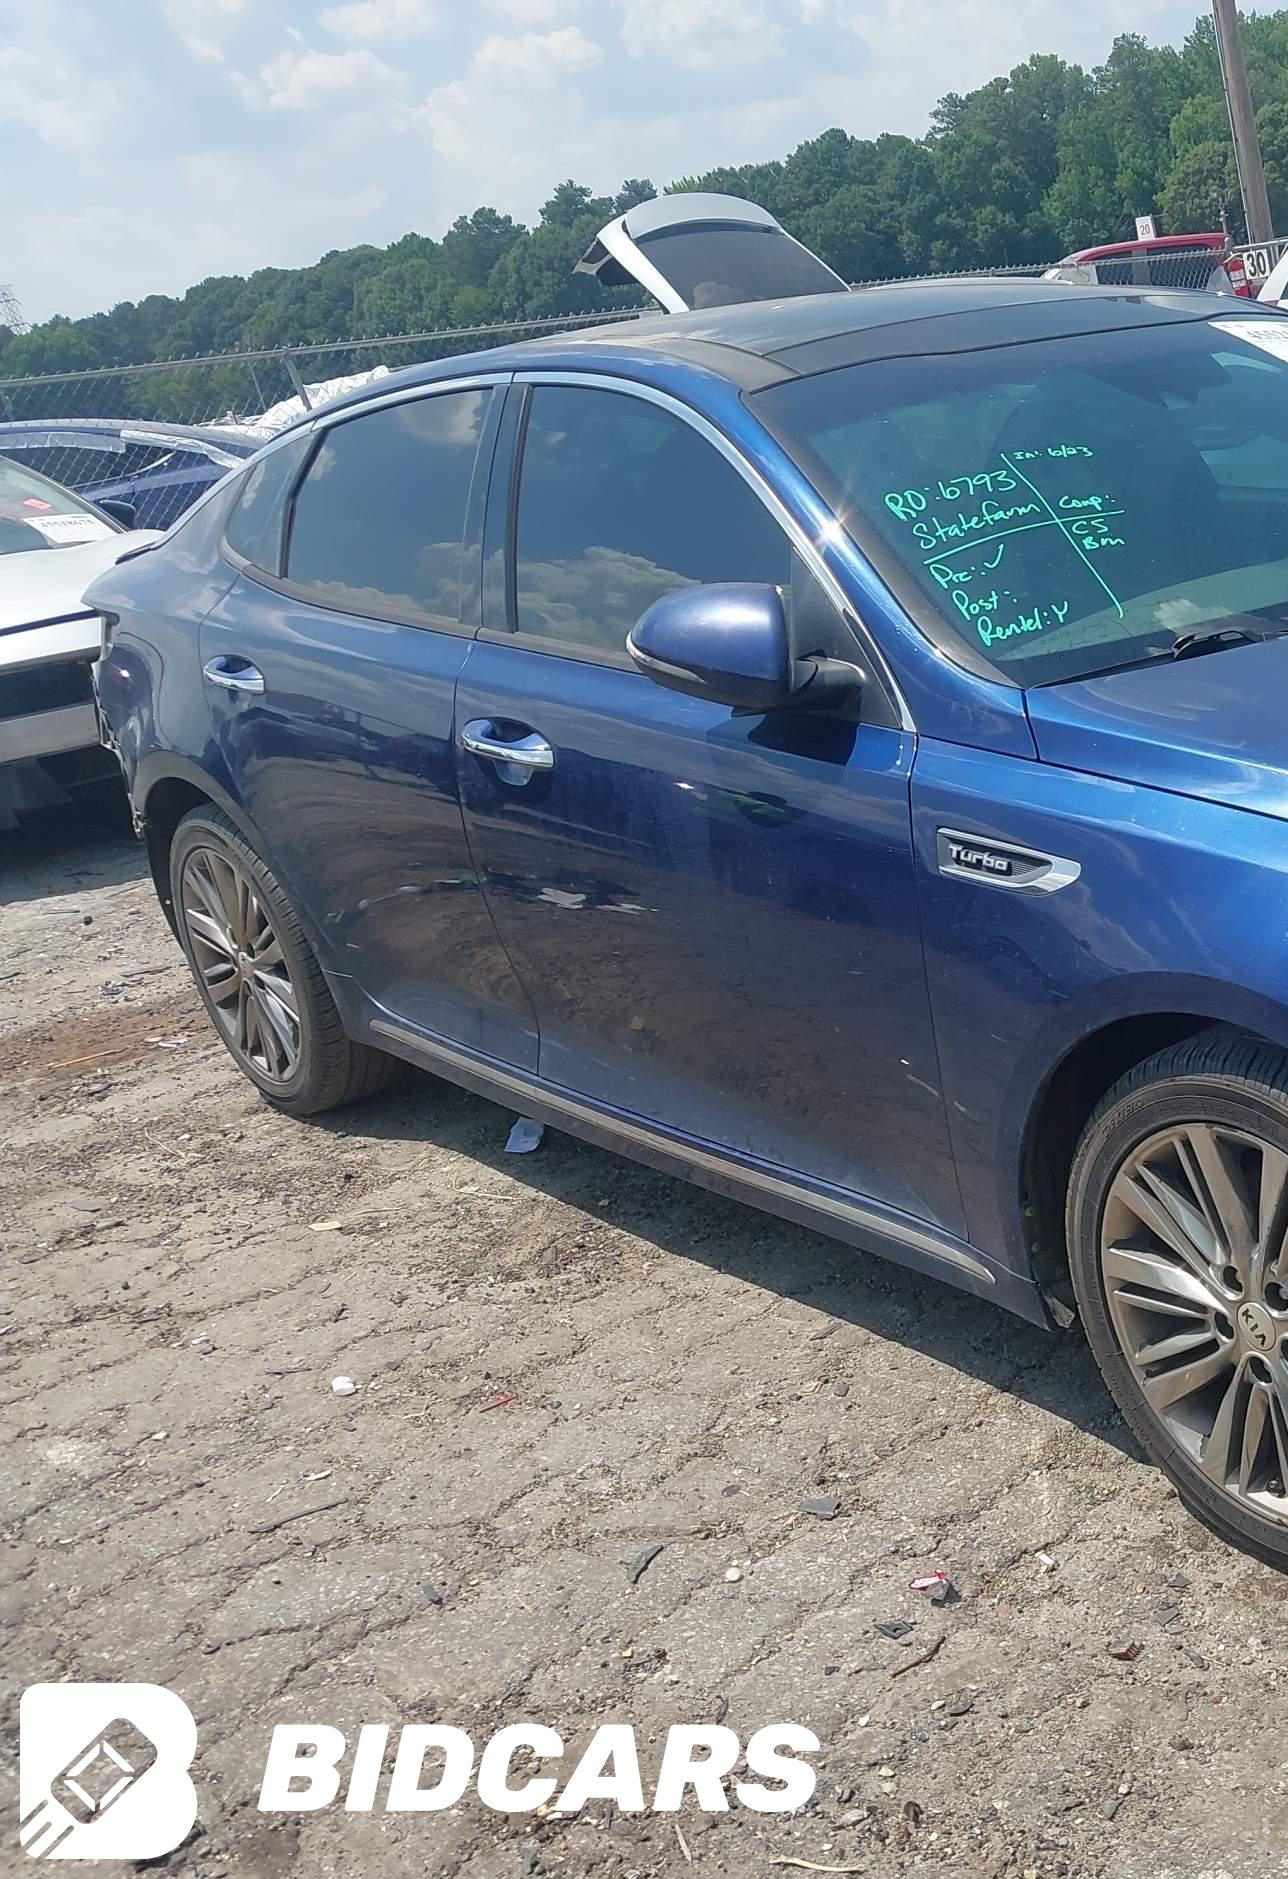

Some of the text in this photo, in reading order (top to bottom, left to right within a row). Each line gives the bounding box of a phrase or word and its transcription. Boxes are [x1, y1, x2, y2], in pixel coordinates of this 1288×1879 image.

[1139, 223, 1151, 236] 20
[1246, 251, 1267, 277] 30
[948, 843, 1010, 872] Turbo
[1241, 1306, 1267, 1347] KIA
